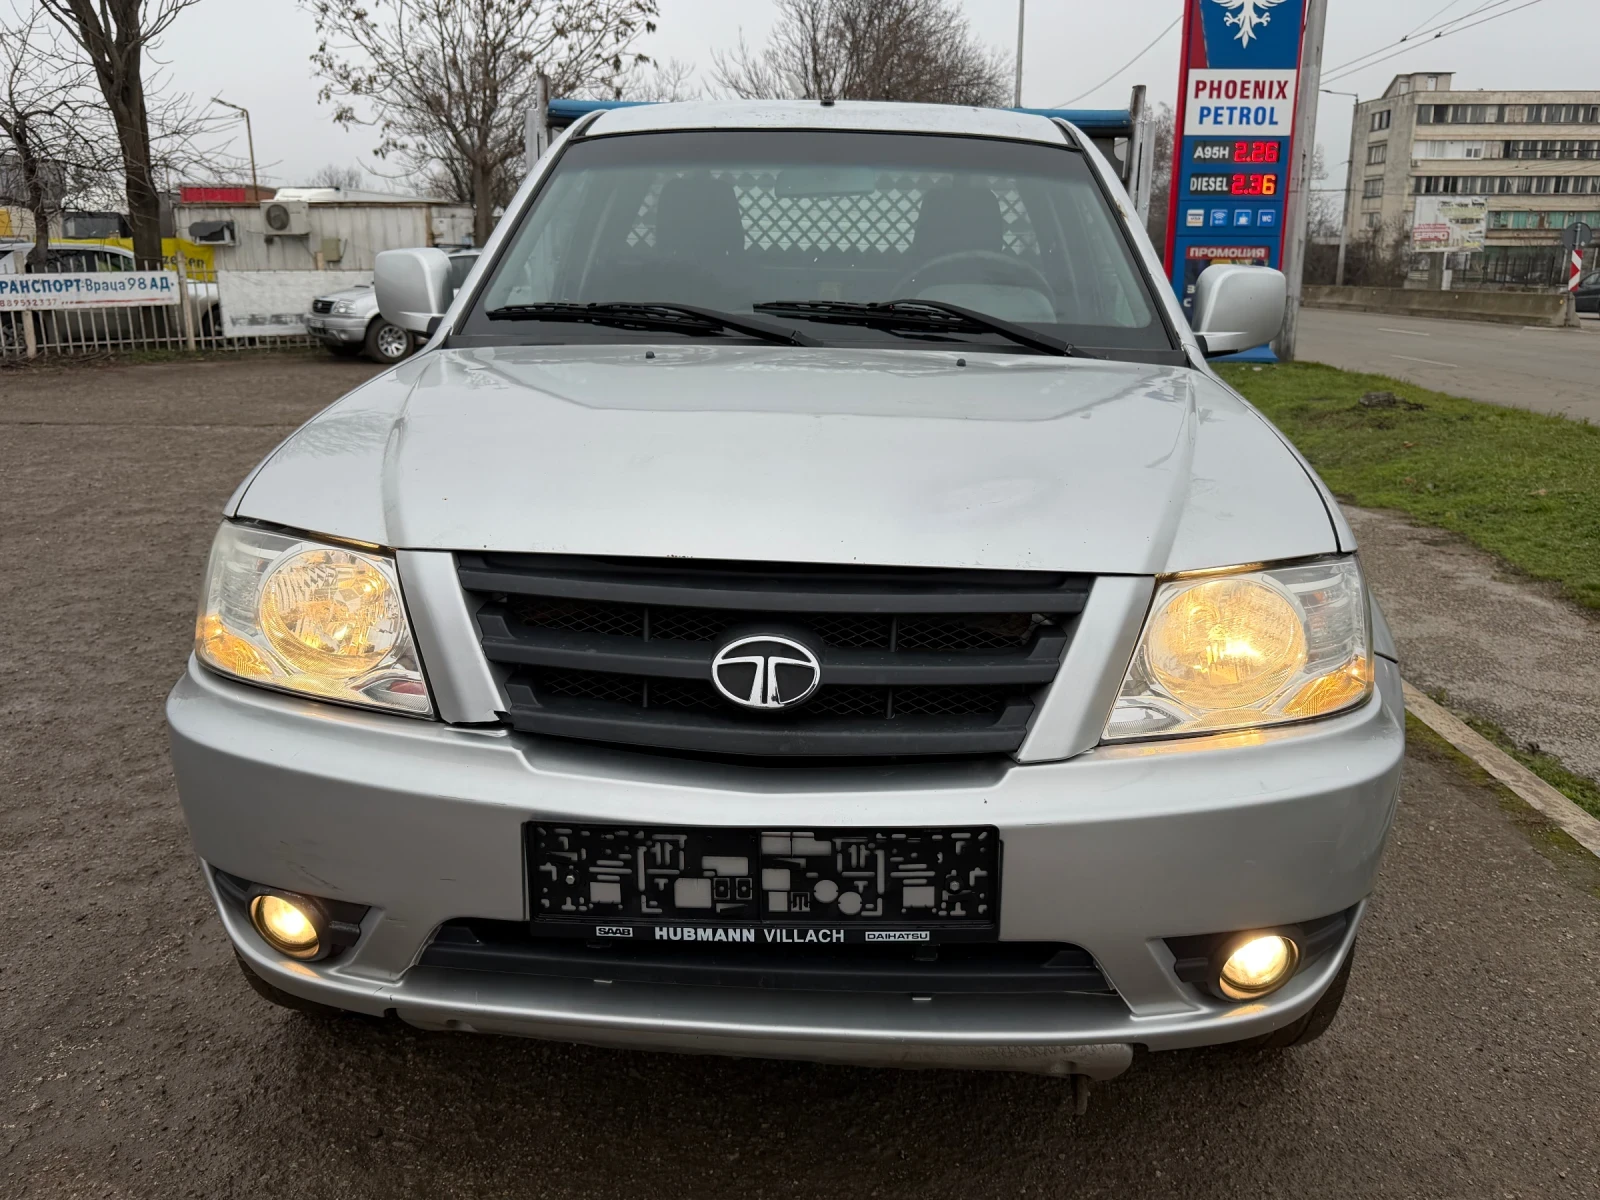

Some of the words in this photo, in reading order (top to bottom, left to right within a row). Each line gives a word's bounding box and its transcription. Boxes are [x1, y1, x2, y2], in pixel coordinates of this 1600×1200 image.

[1194, 80, 1289, 99] PHOENIX
[1198, 106, 1279, 125] PETROL
[1234, 141, 1279, 163] 2.26
[1190, 177, 1228, 191] DIESEL
[1231, 173, 1276, 195] 2.36
[1189, 247, 1265, 258] ПРОМОЦИЯ
[597, 927, 631, 936] SAAB
[655, 926, 755, 943] HUBMANN
[764, 928, 845, 943] VILLACH
[867, 932, 929, 940] DAIHATSU
